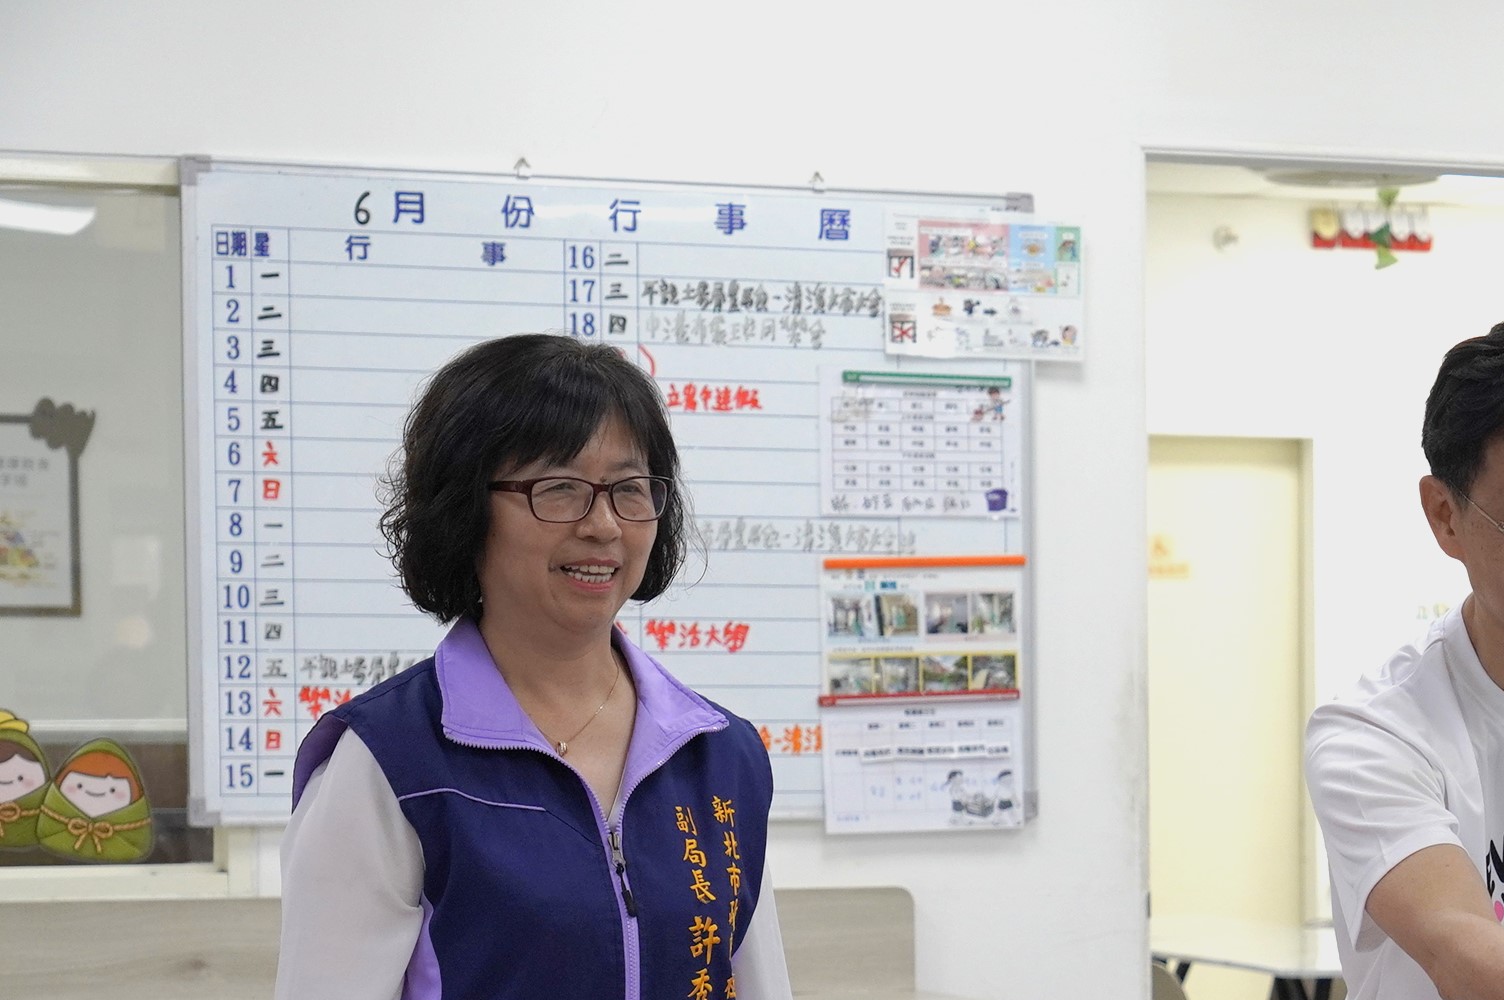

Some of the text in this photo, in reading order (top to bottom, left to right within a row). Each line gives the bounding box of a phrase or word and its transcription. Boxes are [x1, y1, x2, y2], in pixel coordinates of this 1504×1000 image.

[215, 231, 247, 256] 日期
[254, 232, 270, 256] 星
[571, 246, 594, 269] 16
[604, 254, 629, 266] 二
[226, 265, 235, 289] 1
[571, 279, 595, 302] 17
[605, 283, 628, 300] 三
[226, 299, 239, 323] 2
[257, 306, 282, 320] 二
[571, 313, 595, 337] 18
[609, 315, 627, 335] 四
[227, 335, 240, 360] 3
[257, 340, 280, 359] 三
[224, 369, 237, 394] 4
[260, 375, 279, 393] 四
[228, 407, 240, 432] 5
[261, 411, 283, 430] 五
[228, 442, 241, 466] 6
[262, 441, 279, 467] 六
[228, 479, 241, 503] 7
[263, 479, 280, 499] 日
[229, 513, 242, 537] 8
[230, 550, 243, 574] 9
[261, 555, 284, 567] 二
[225, 585, 250, 608] 10
[260, 589, 284, 606] 三
[225, 620, 248, 644] 11
[265, 624, 281, 640] 四
[225, 655, 251, 679] 12
[263, 660, 287, 677] 五
[227, 691, 251, 715] 13
[263, 688, 282, 717] 六
[227, 727, 252, 751] 14
[266, 730, 281, 750] 日
[228, 764, 253, 788] 15
